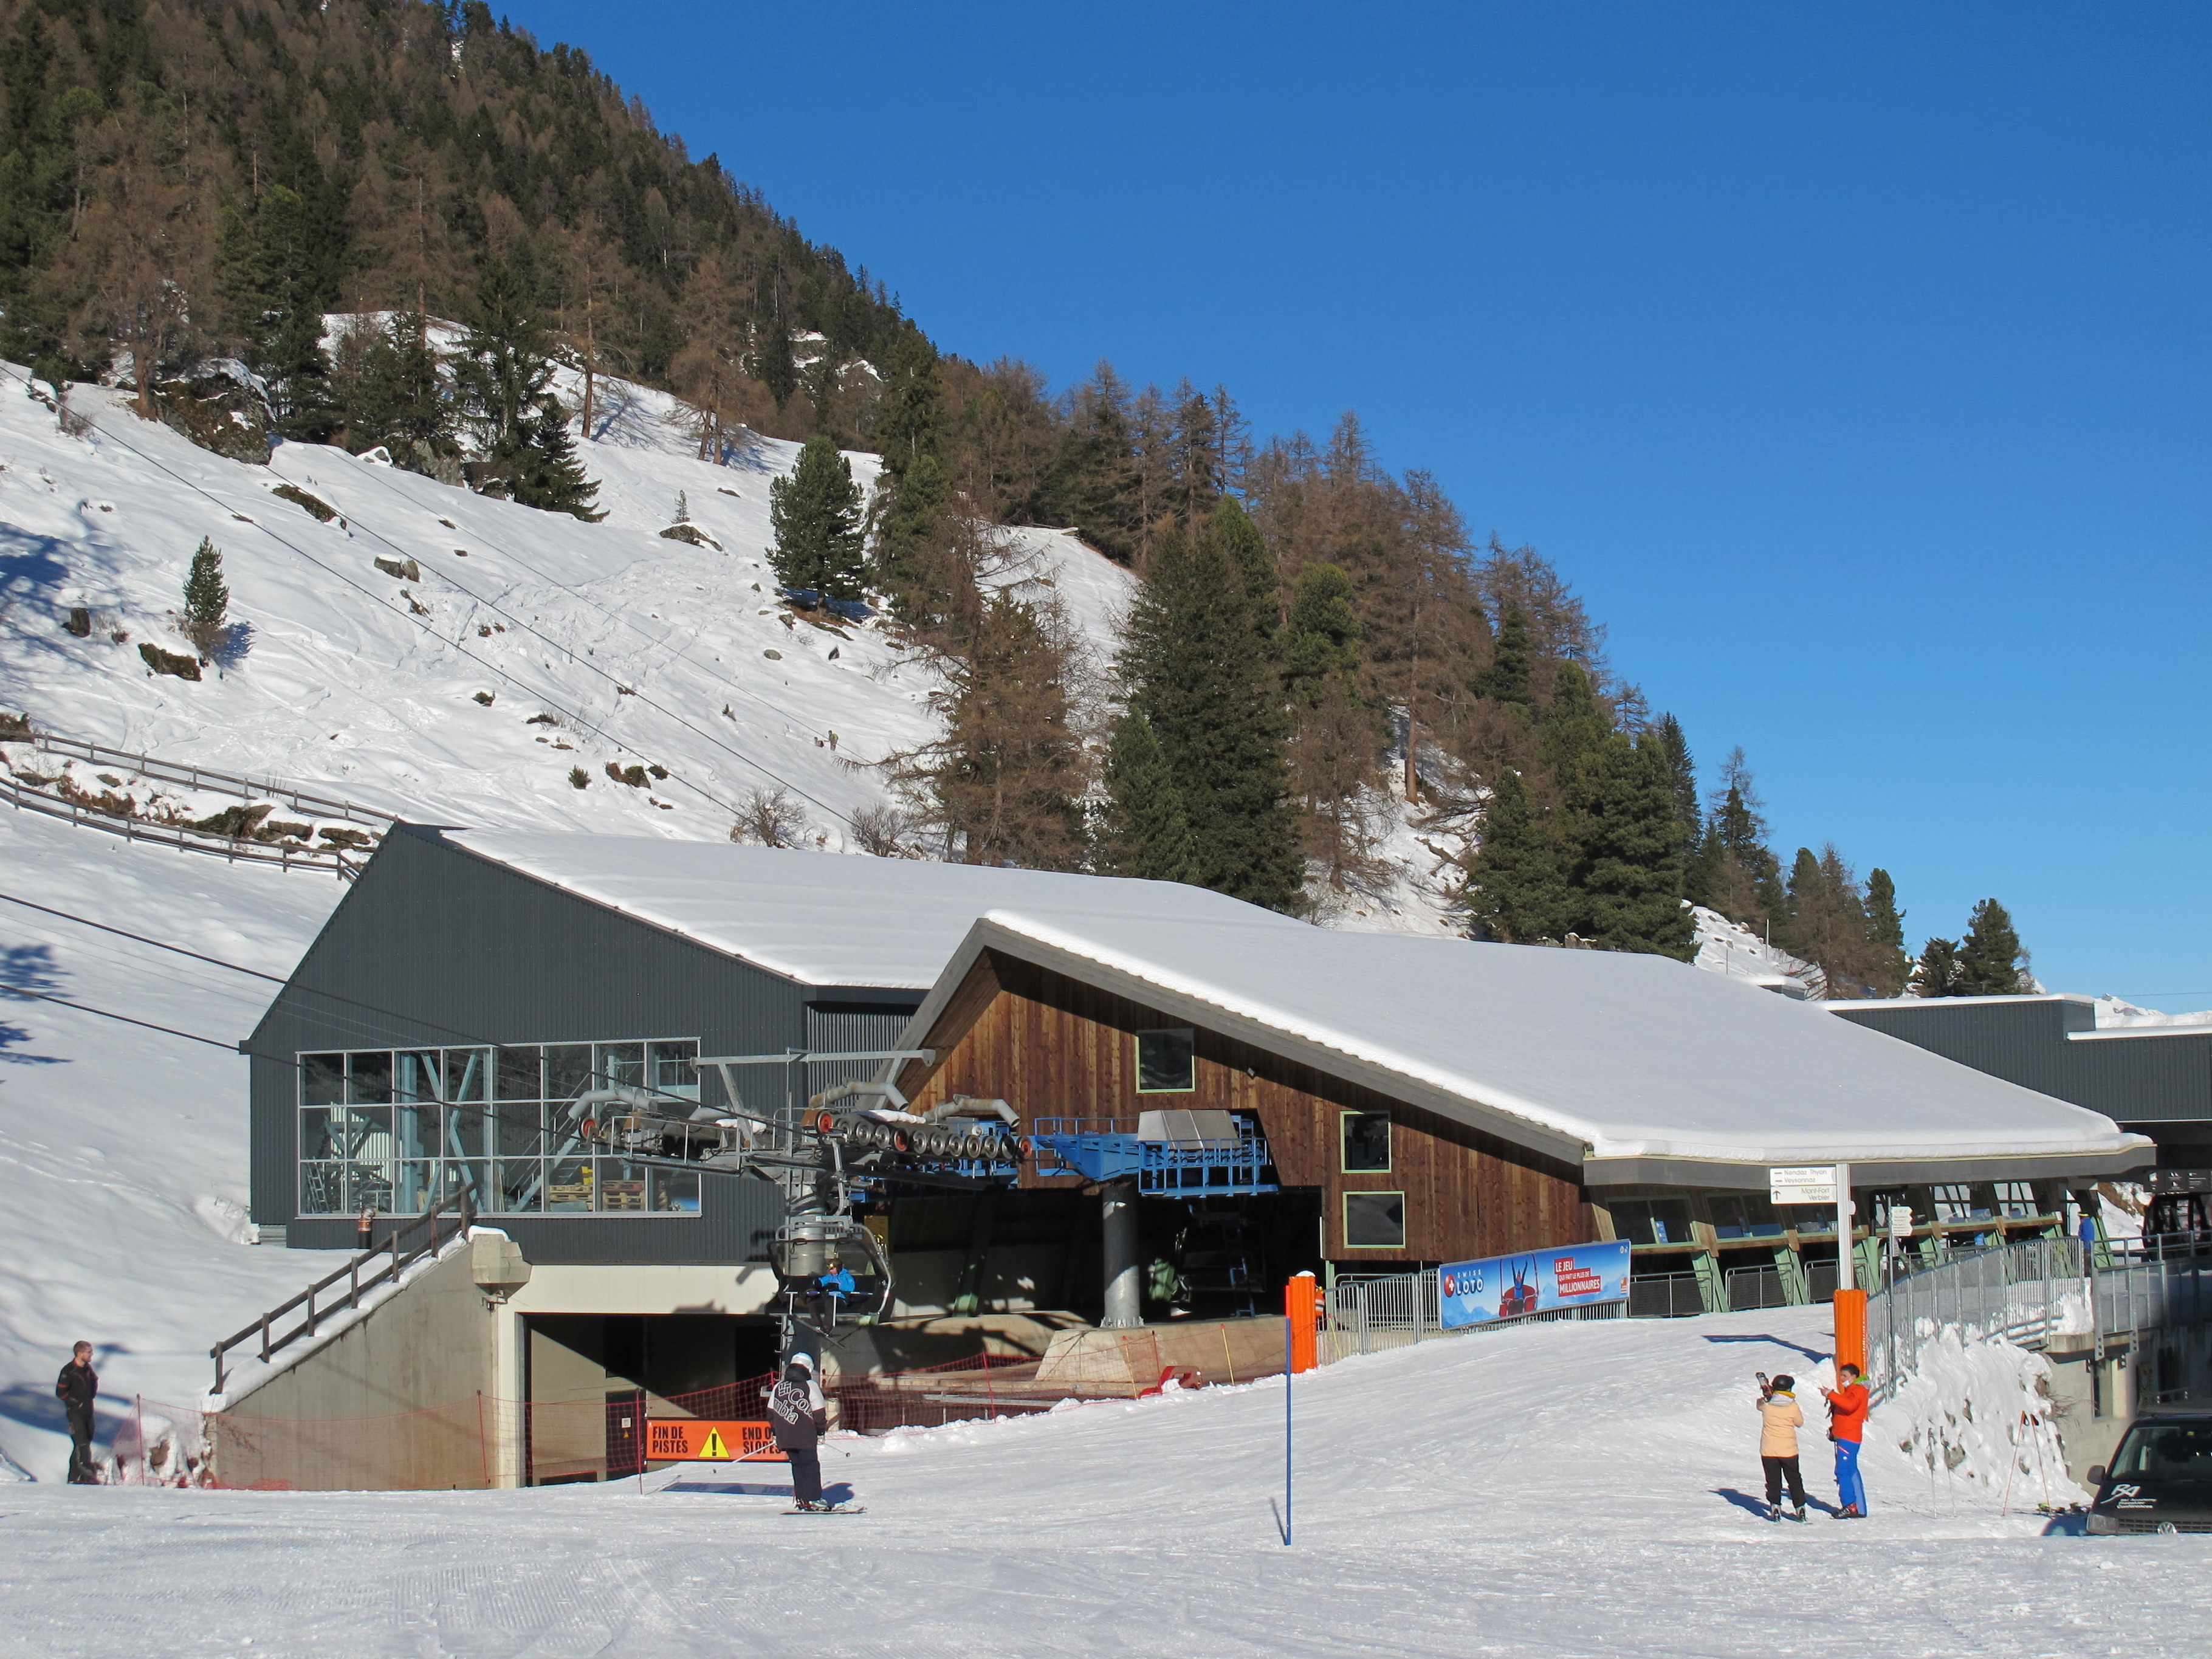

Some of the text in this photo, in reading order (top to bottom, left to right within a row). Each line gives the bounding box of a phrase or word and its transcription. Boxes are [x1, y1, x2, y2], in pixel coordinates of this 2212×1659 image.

[1555, 1260, 1573, 1272] LE JEU
[1457, 1269, 1481, 1279] SWISS
[1457, 1279, 1483, 1294] LOTO
[1559, 1279, 1600, 1294] MILLIONNAIRES
[653, 1426, 683, 1439] FIN DE
[743, 1427, 773, 1440] END O
[653, 1440, 688, 1453] PISTES
